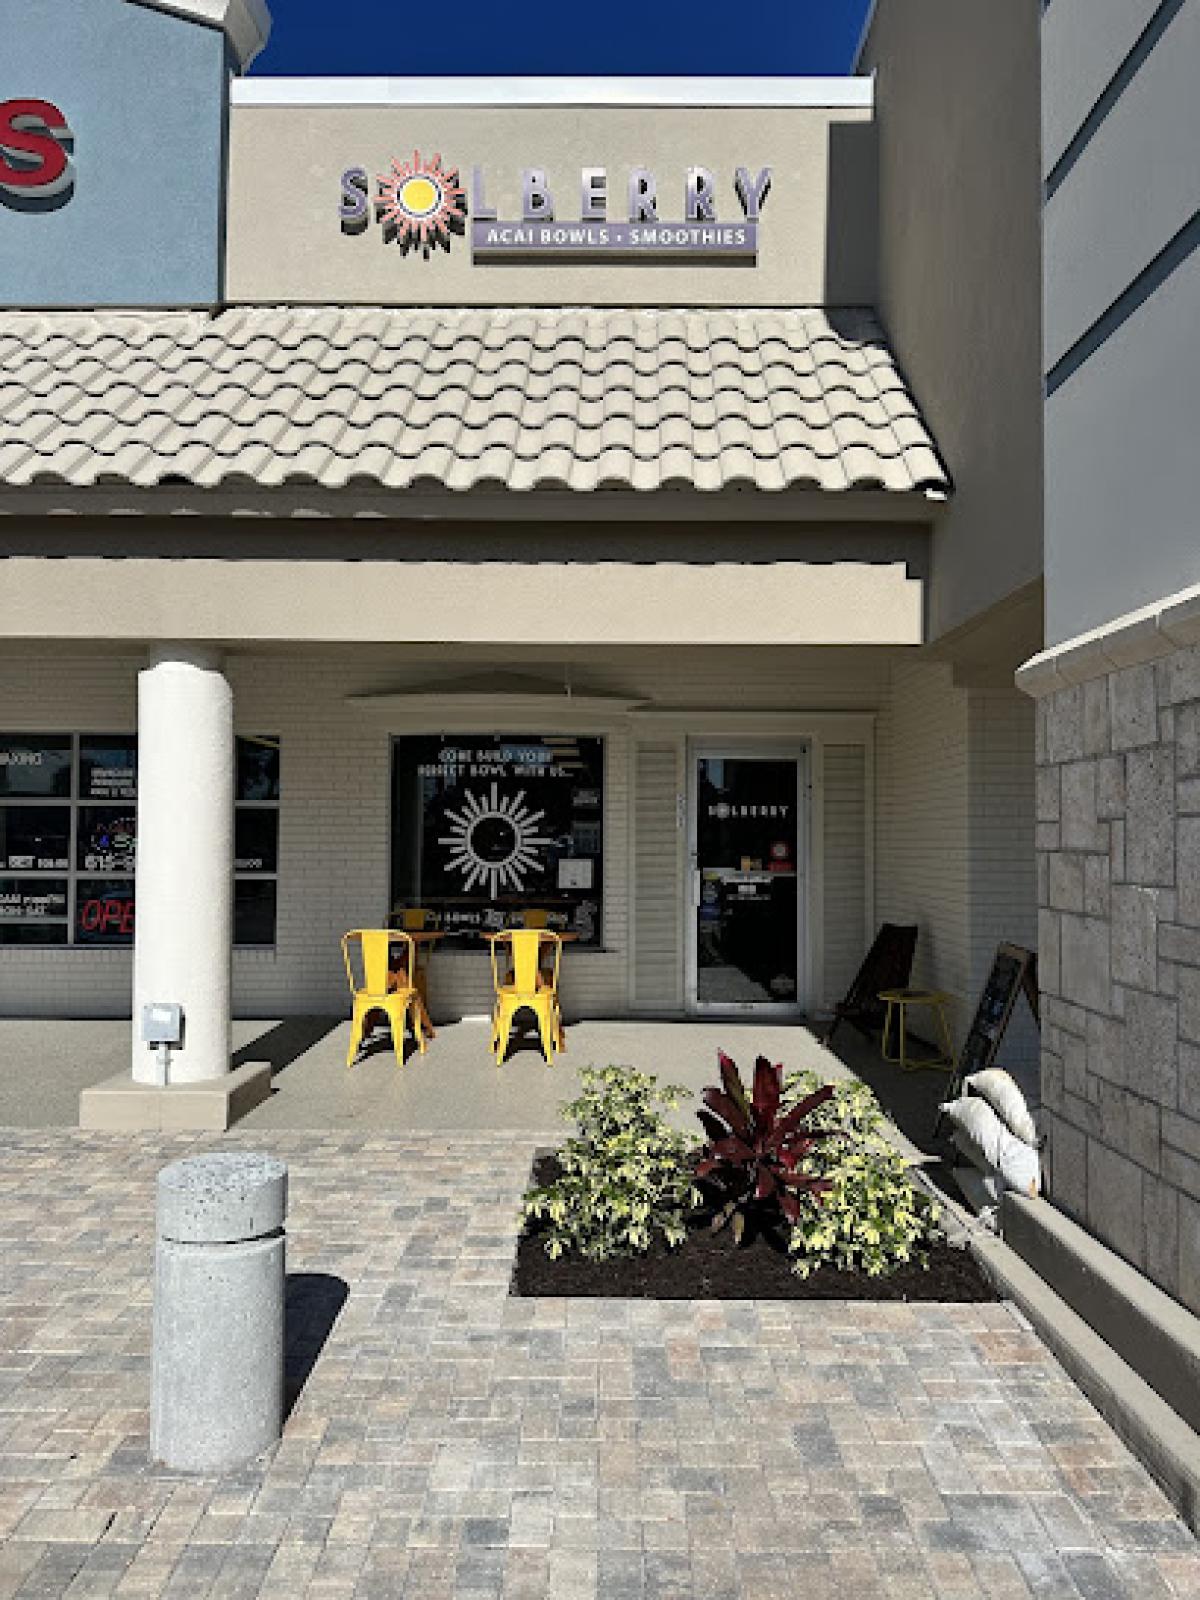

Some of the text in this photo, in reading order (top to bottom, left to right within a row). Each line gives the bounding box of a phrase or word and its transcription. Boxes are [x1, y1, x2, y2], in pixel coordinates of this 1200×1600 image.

[487, 229, 747, 245] ACAI BOWLS SMOOTHIES
[81, 899, 135, 933] OPE
